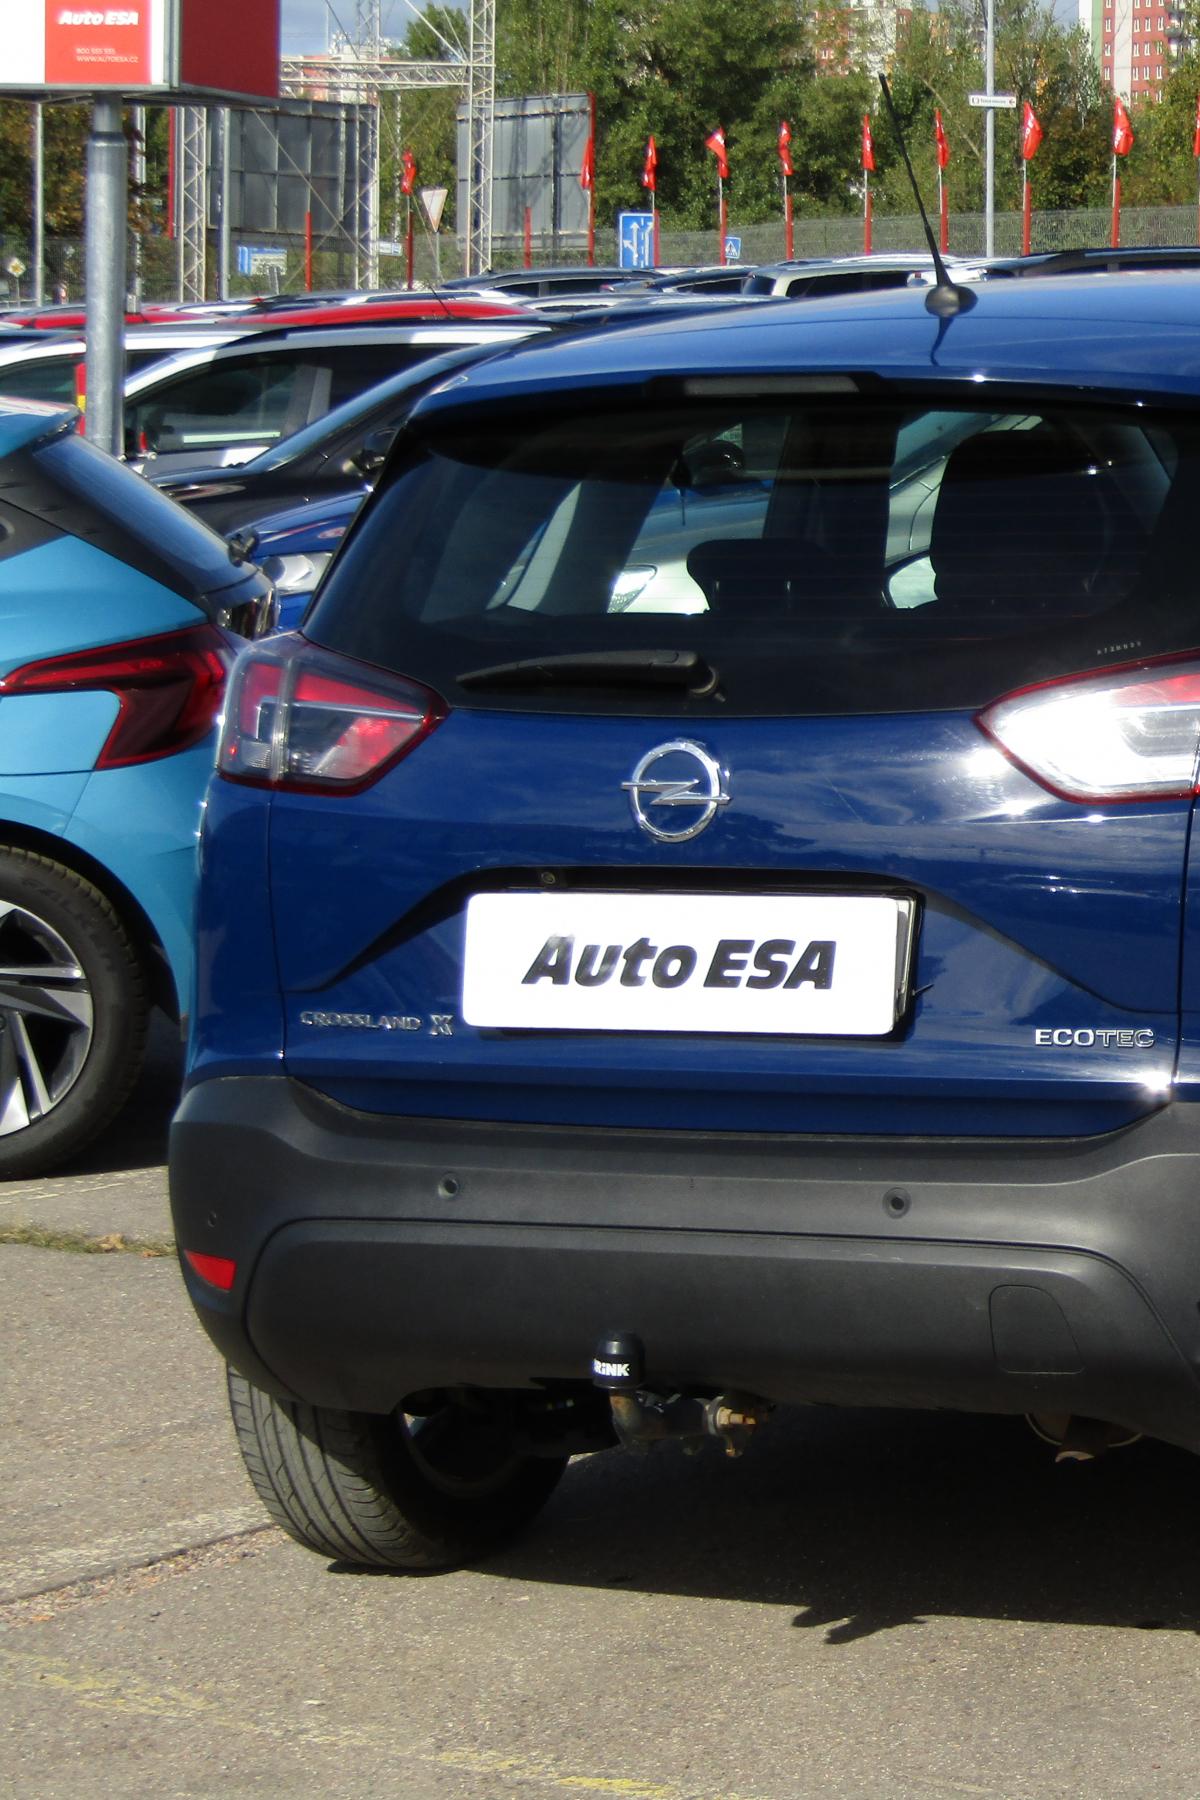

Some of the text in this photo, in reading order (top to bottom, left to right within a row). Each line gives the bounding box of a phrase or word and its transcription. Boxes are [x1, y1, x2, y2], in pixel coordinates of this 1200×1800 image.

[59, 11, 139, 25] Auto ESA
[521, 934, 837, 990] Auto ESA
[300, 1011, 453, 1036] CROSSLAND X
[1035, 1028, 1154, 1047] ECOTEC
